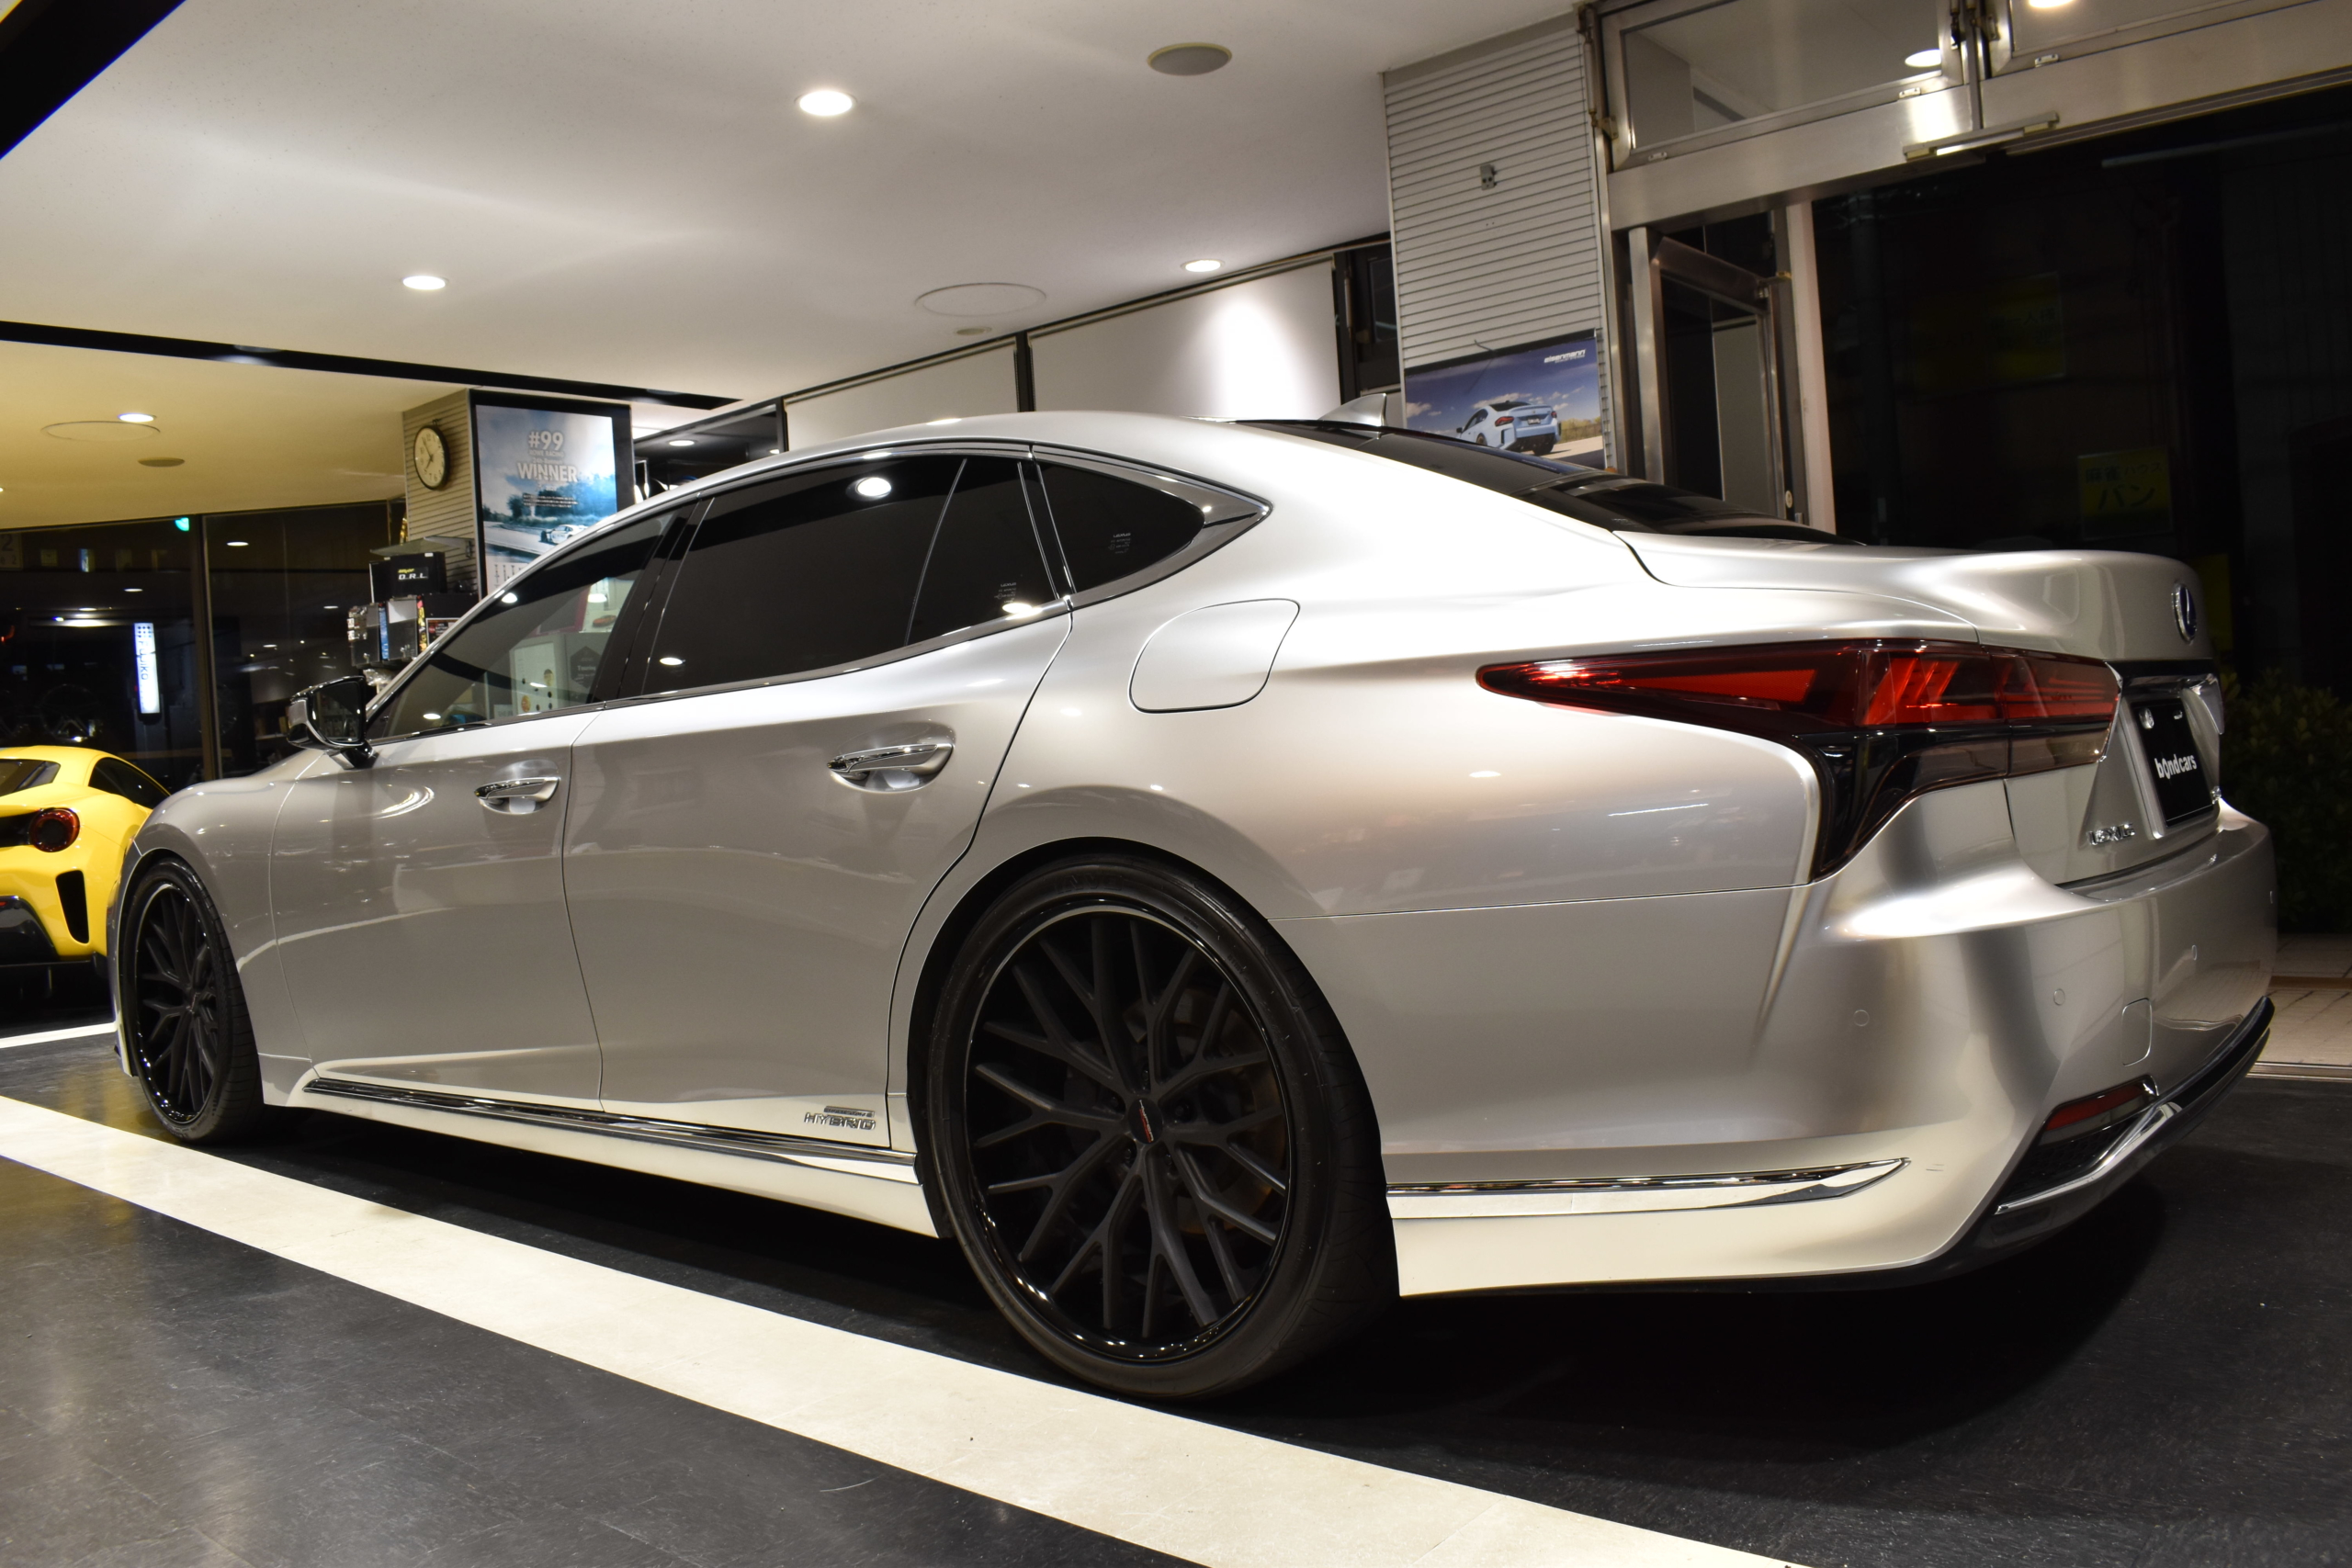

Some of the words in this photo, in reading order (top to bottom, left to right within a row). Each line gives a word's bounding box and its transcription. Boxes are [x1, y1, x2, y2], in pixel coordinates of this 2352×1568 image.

[528, 430, 564, 450] #99
[516, 462, 578, 483] WINNER
[804, 1111, 876, 1131] HYBRID
